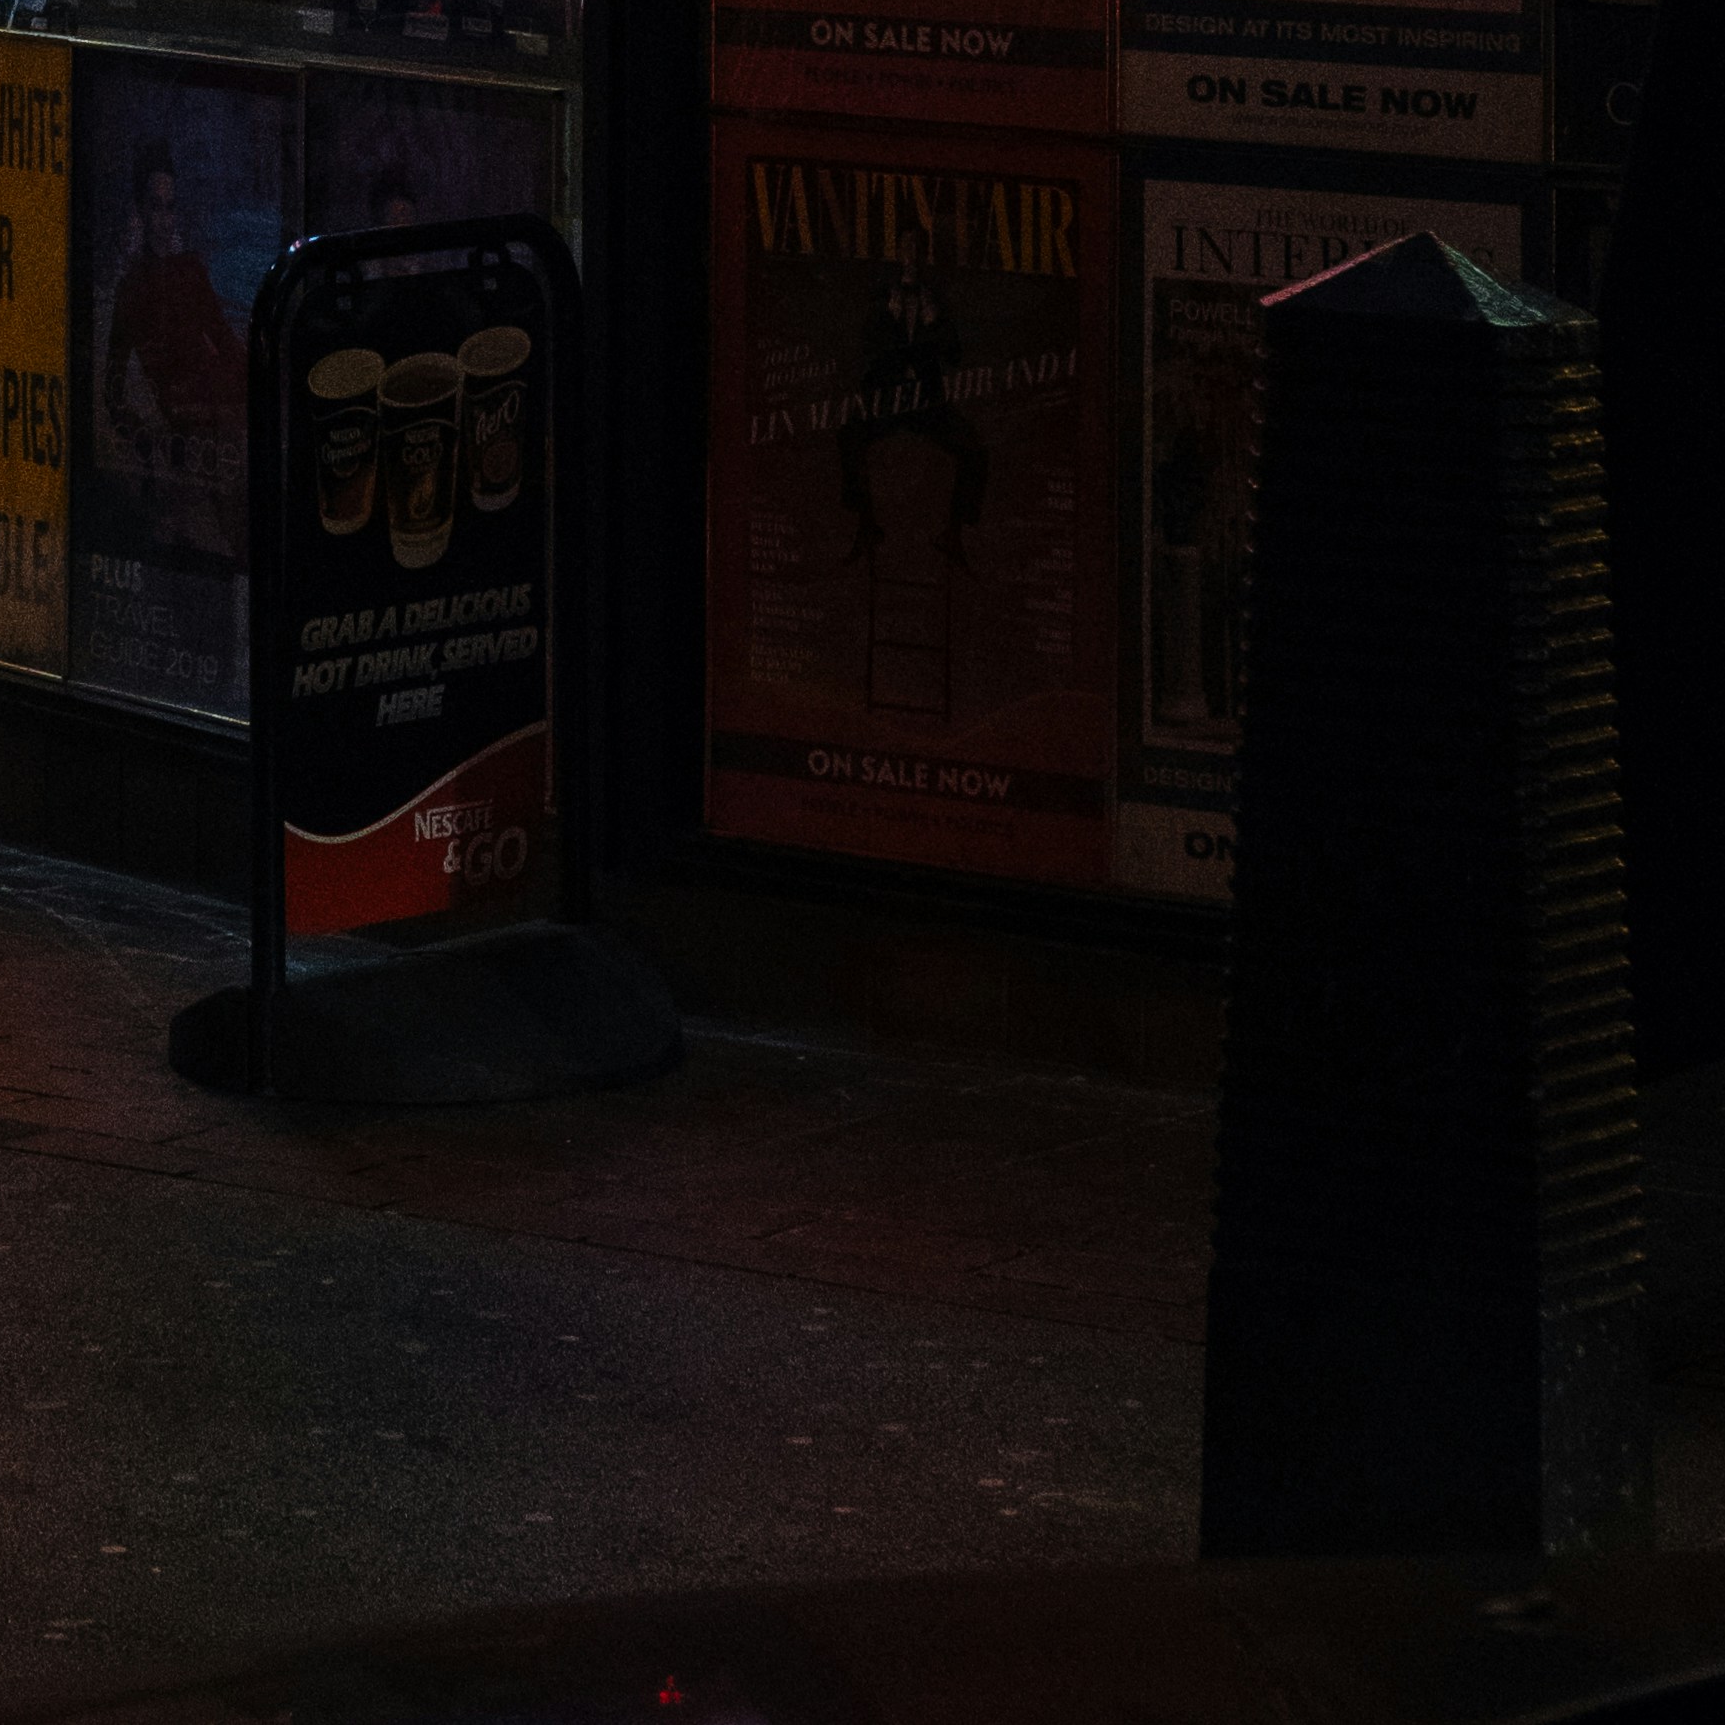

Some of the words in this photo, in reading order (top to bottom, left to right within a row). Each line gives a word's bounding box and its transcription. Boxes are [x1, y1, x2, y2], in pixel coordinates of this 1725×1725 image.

[809, 18, 855, 47] ON
[863, 21, 932, 53] SALE
[940, 27, 1015, 58] NOW
[1144, 12, 1235, 37] DESIGN
[1242, 18, 1269, 38] AT
[1320, 22, 1392, 46] MOST
[1187, 74, 1247, 105] ON
[1262, 79, 1367, 113] SALE
[1380, 88, 1477, 119] NOW
[91, 553, 144, 594] PLUS
[301, 609, 375, 652] GRAB
[376, 606, 398, 641] A
[401, 582, 533, 635] DELICIOUS
[292, 657, 354, 698] HOT
[440, 625, 539, 673] SERVED
[376, 683, 447, 728] HERE
[806, 747, 854, 779] ON
[860, 754, 929, 791] SALE
[936, 766, 1014, 799] NOW
